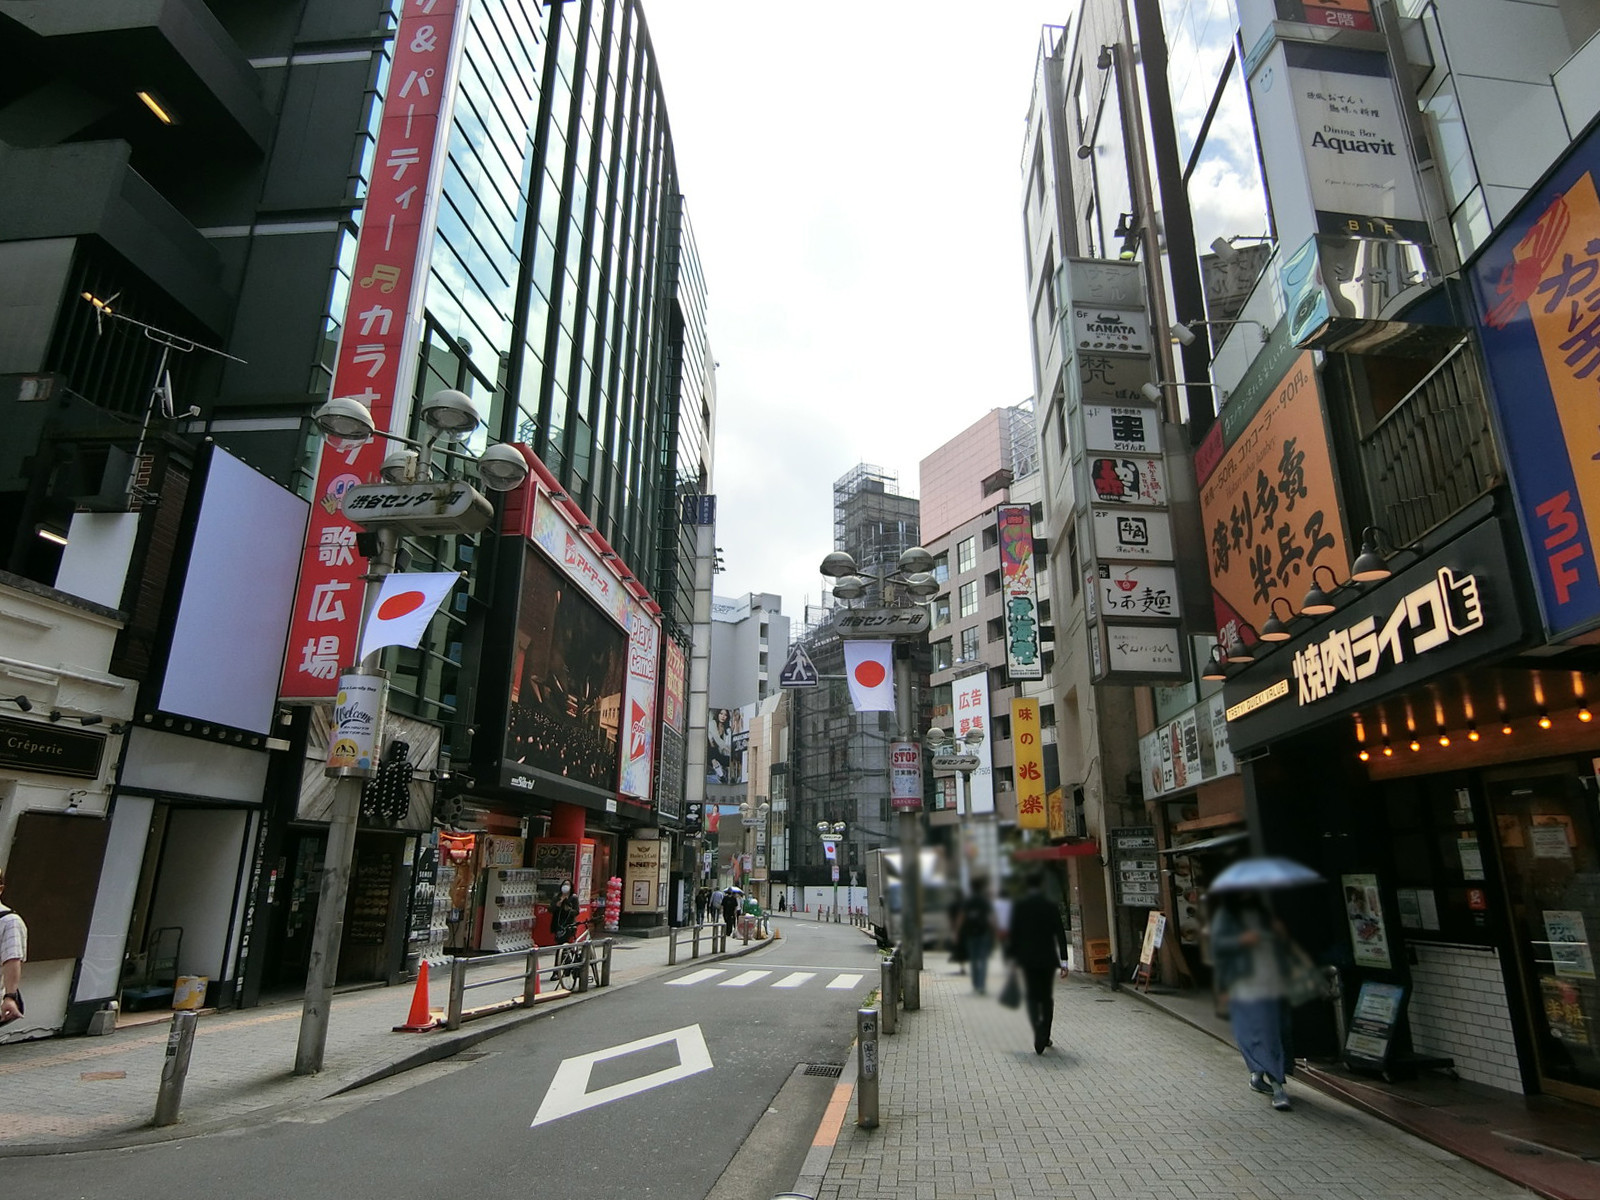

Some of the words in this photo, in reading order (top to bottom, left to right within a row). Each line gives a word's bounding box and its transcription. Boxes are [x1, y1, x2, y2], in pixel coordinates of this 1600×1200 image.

[1325, 11, 1355, 26] 2階
[1323, 125, 1355, 137] Dining
[1360, 129, 1376, 137] Bar
[1312, 131, 1396, 156] Aquavit
[1348, 220, 1394, 234] B1F
[1076, 311, 1089, 319] 6F
[1086, 323, 1136, 335] KANATA
[348, 491, 465, 509] 渋谷センター街
[1122, 522, 1145, 539] 牛角
[1535, 491, 1584, 605] 3F
[299, 526, 357, 680] 歌広場
[839, 614, 924, 627] 渋谷センター街
[630, 614, 653, 652] Play!
[1292, 579, 1450, 706] 焼肉ライク
[630, 648, 656, 680] Game!
[959, 689, 982, 710] 広告
[335, 702, 373, 725] Welcome
[960, 715, 984, 737] 募集
[894, 752, 917, 763] STOP
